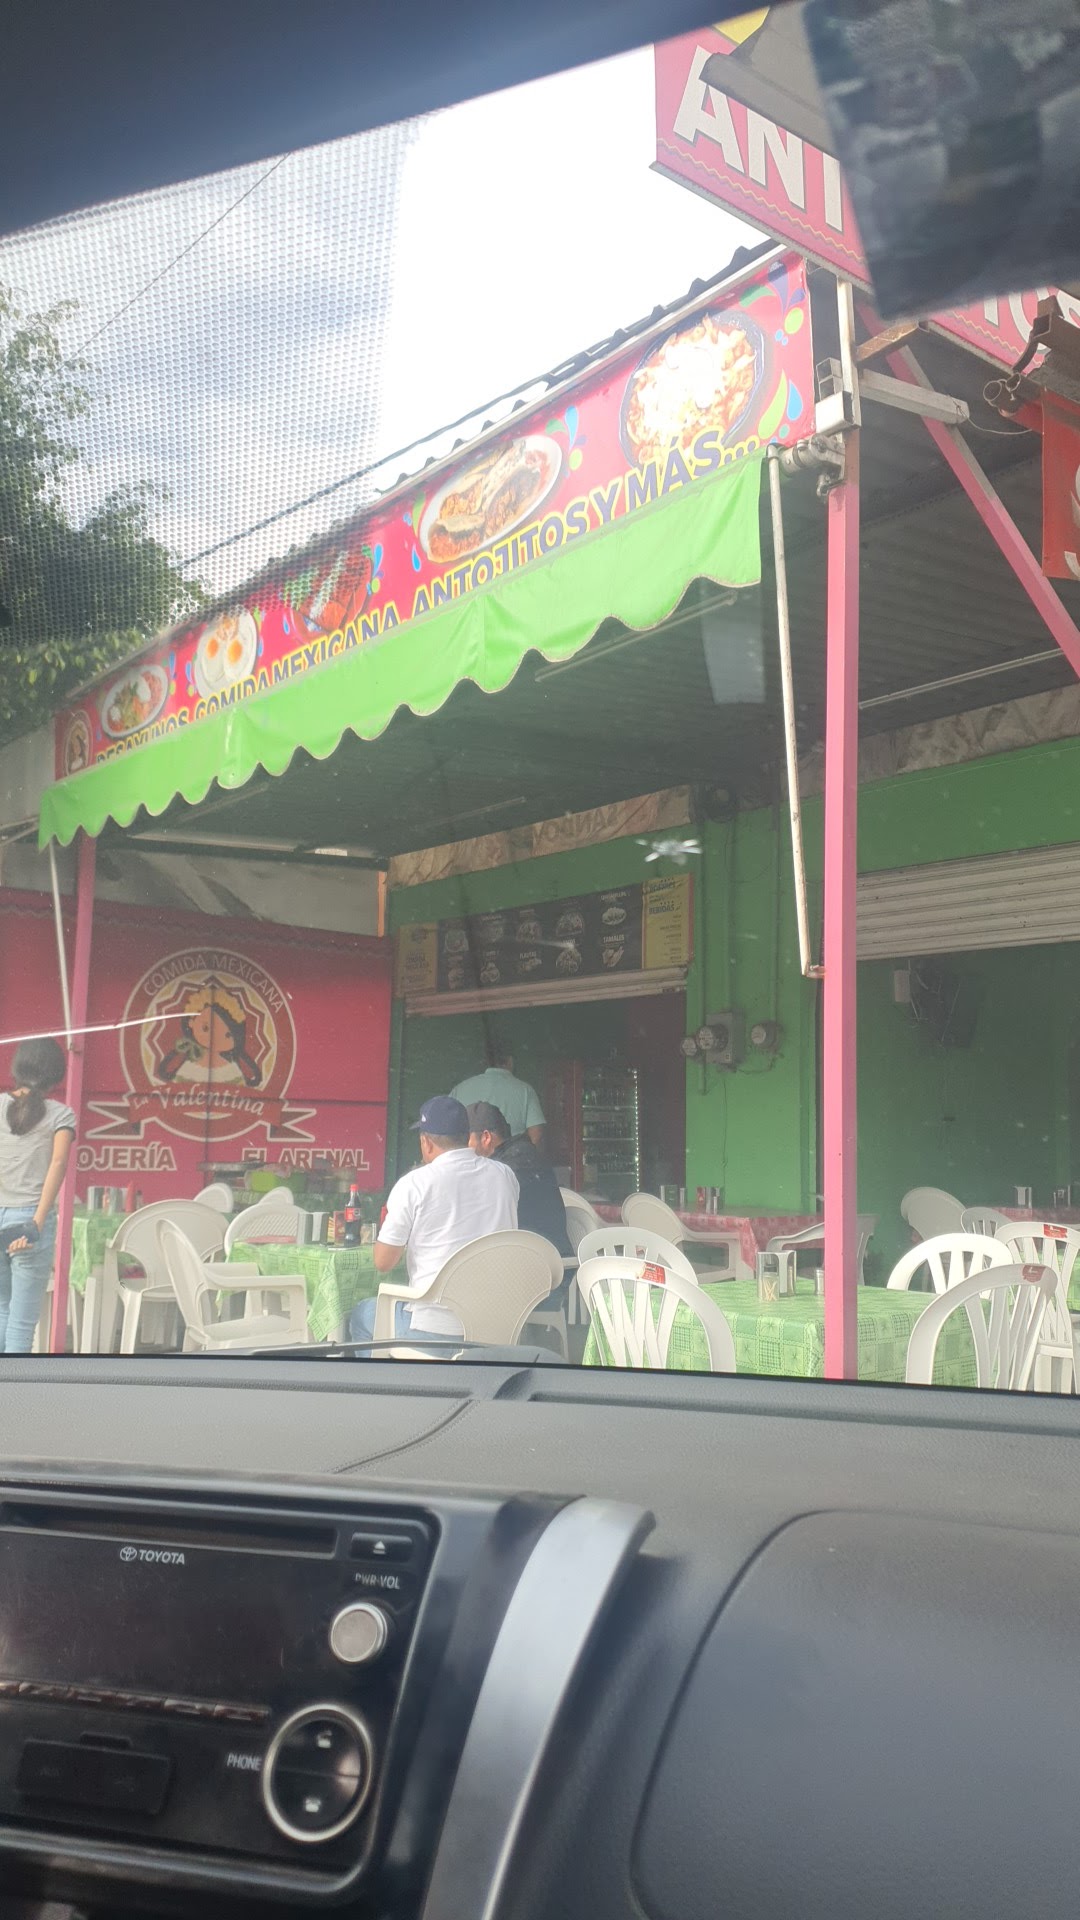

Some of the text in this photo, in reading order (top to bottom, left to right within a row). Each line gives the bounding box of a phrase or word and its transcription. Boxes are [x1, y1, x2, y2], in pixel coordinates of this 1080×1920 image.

[195, 671, 270, 720] COMIDA
[272, 601, 400, 685] MEXICANA
[412, 496, 589, 619] ANTOJITOS
[589, 476, 622, 526] Y
[143, 954, 284, 1014] COMIDA MEXICANA
[133, 1083, 265, 1116] La Valentina
[279, 1148, 370, 1171] ARENAL
[138, 1549, 186, 1565] TOYOTA
[226, 1752, 262, 1771] PHONE
